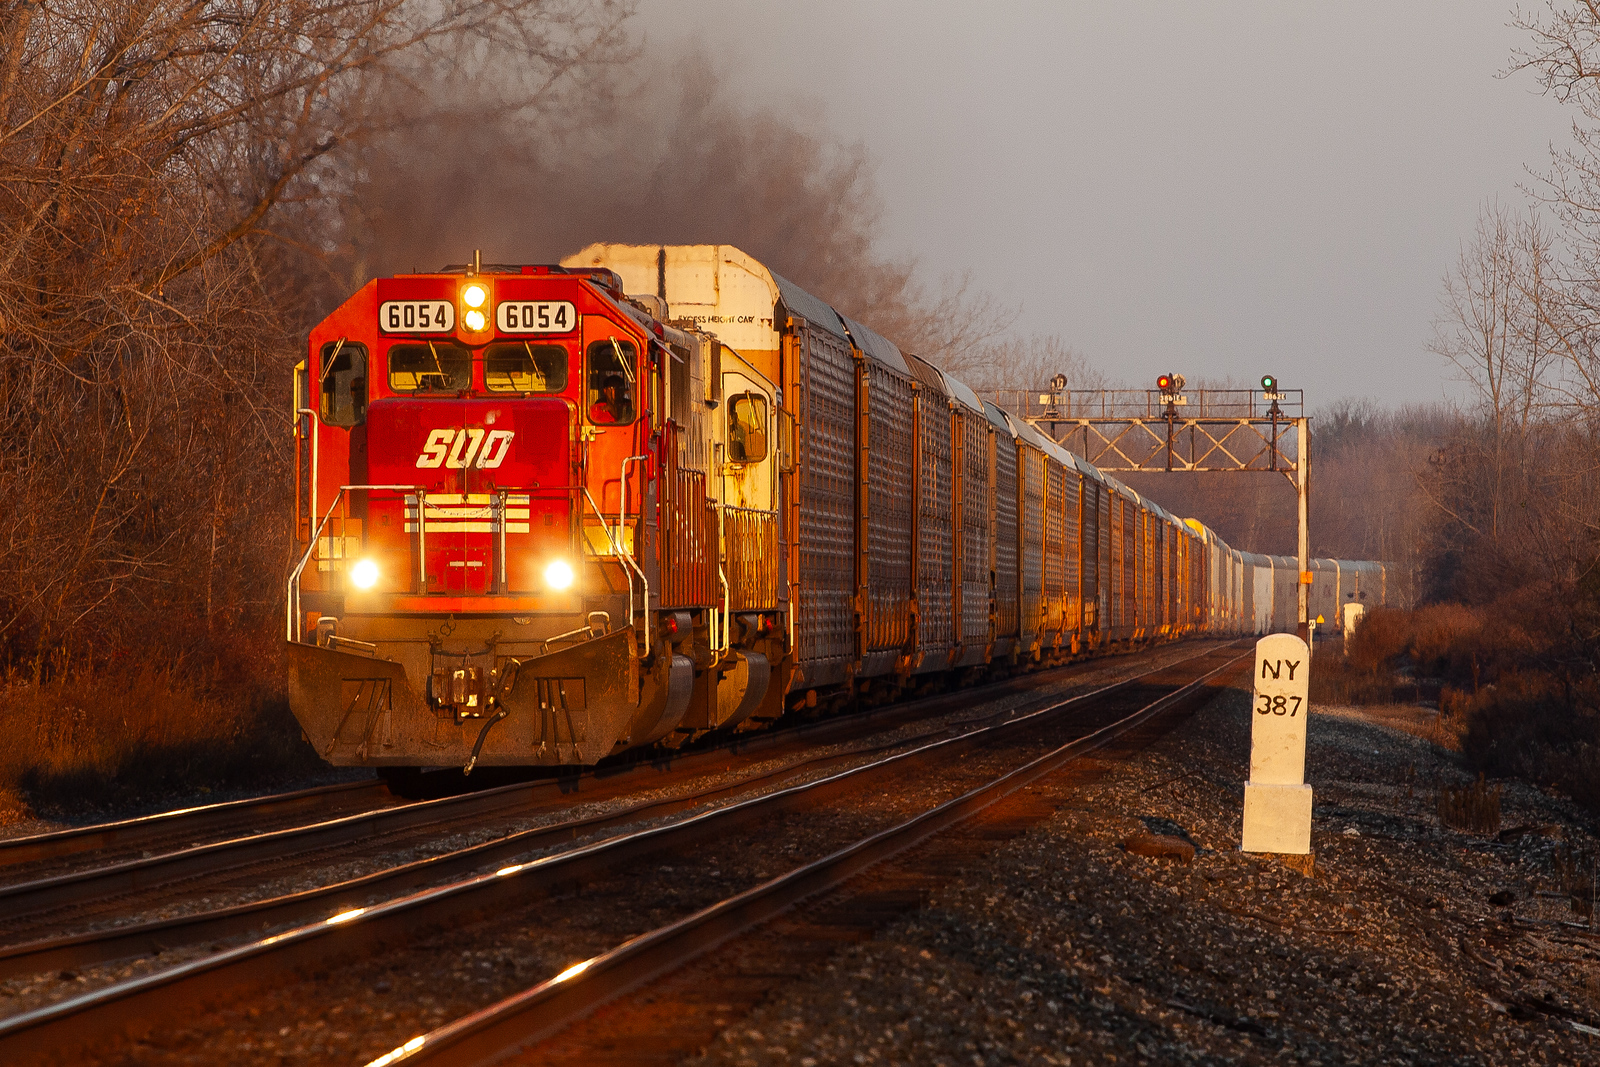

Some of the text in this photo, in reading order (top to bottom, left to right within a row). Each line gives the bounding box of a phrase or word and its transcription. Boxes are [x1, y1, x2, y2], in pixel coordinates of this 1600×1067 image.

[389, 305, 446, 328] 6054
[506, 305, 567, 328] 6054
[737, 315, 754, 324] CAR
[416, 428, 515, 469] SOO
[1262, 659, 1301, 680] NY
[1257, 694, 1303, 717] 387
